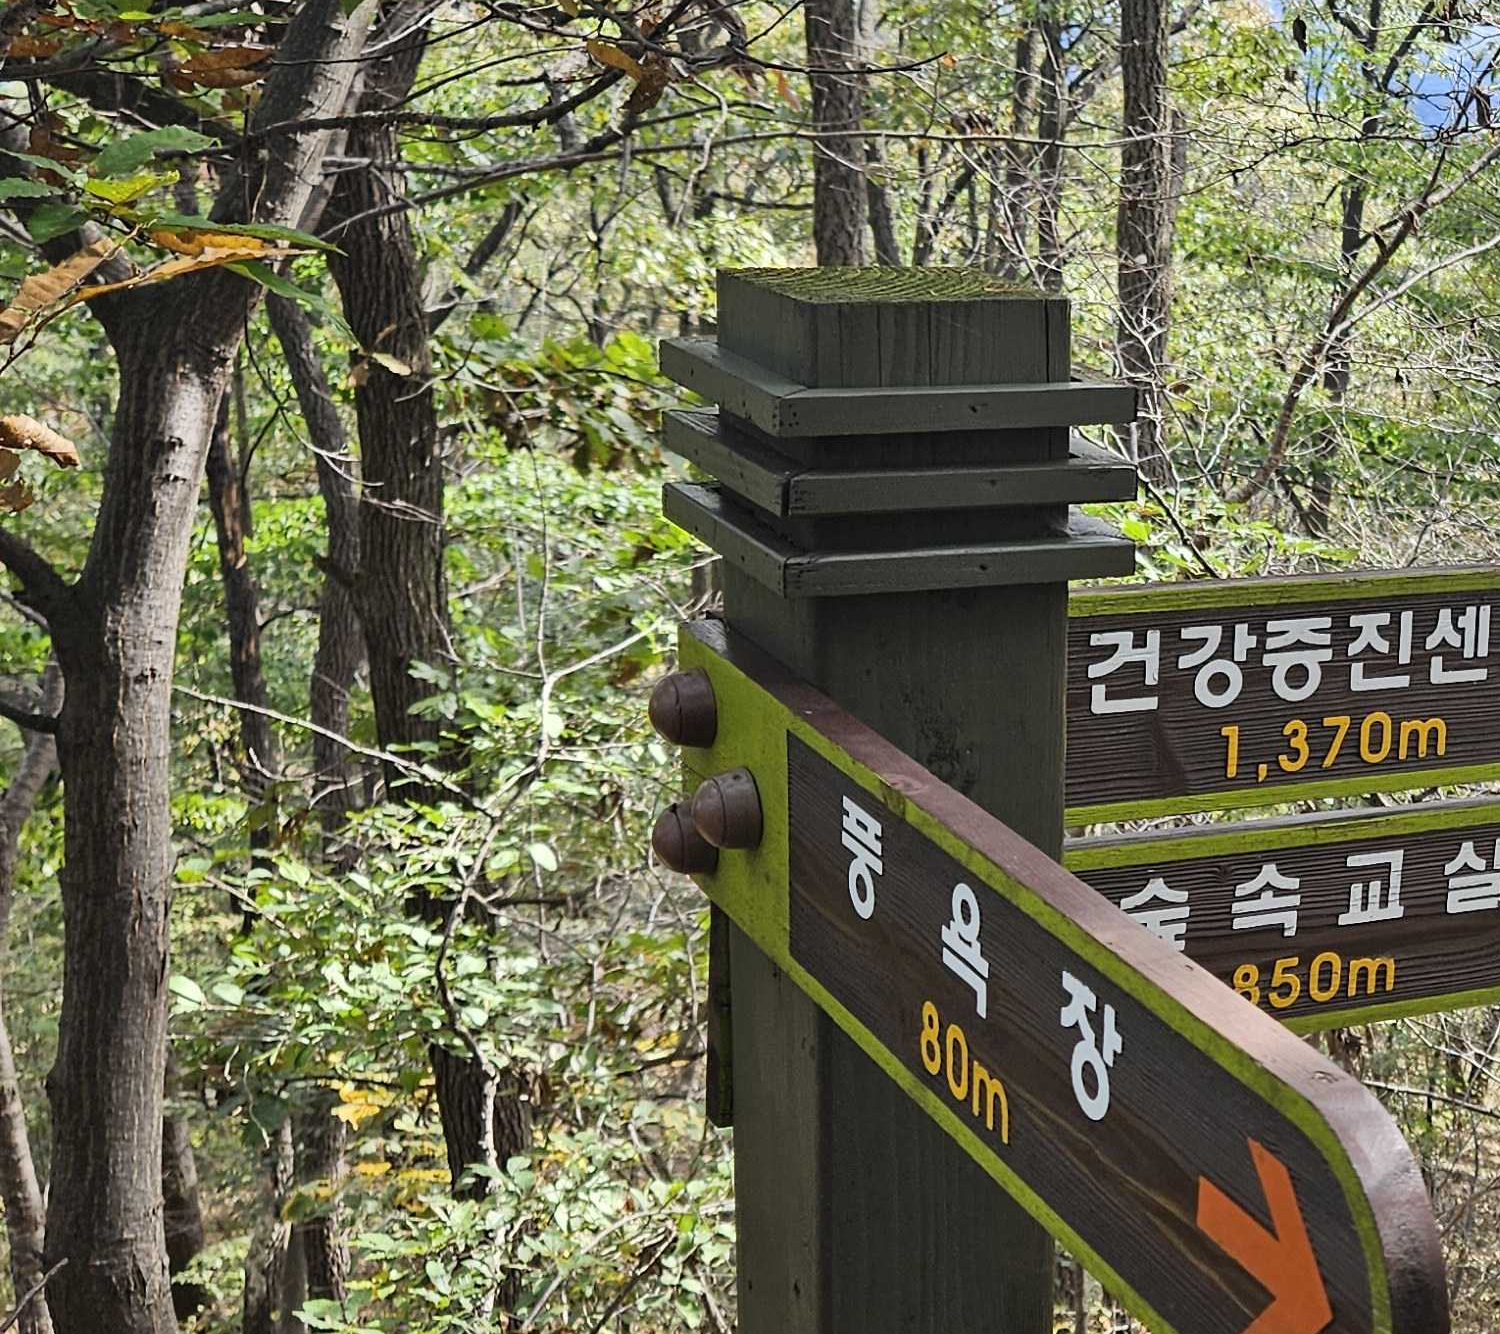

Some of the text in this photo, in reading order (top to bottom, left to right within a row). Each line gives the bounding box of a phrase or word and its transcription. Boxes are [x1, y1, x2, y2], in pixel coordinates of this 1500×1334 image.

[1220, 712, 1447, 784] 1,370m
[1232, 952, 1396, 1009] 850m
[921, 1001, 1009, 1144] 80m
